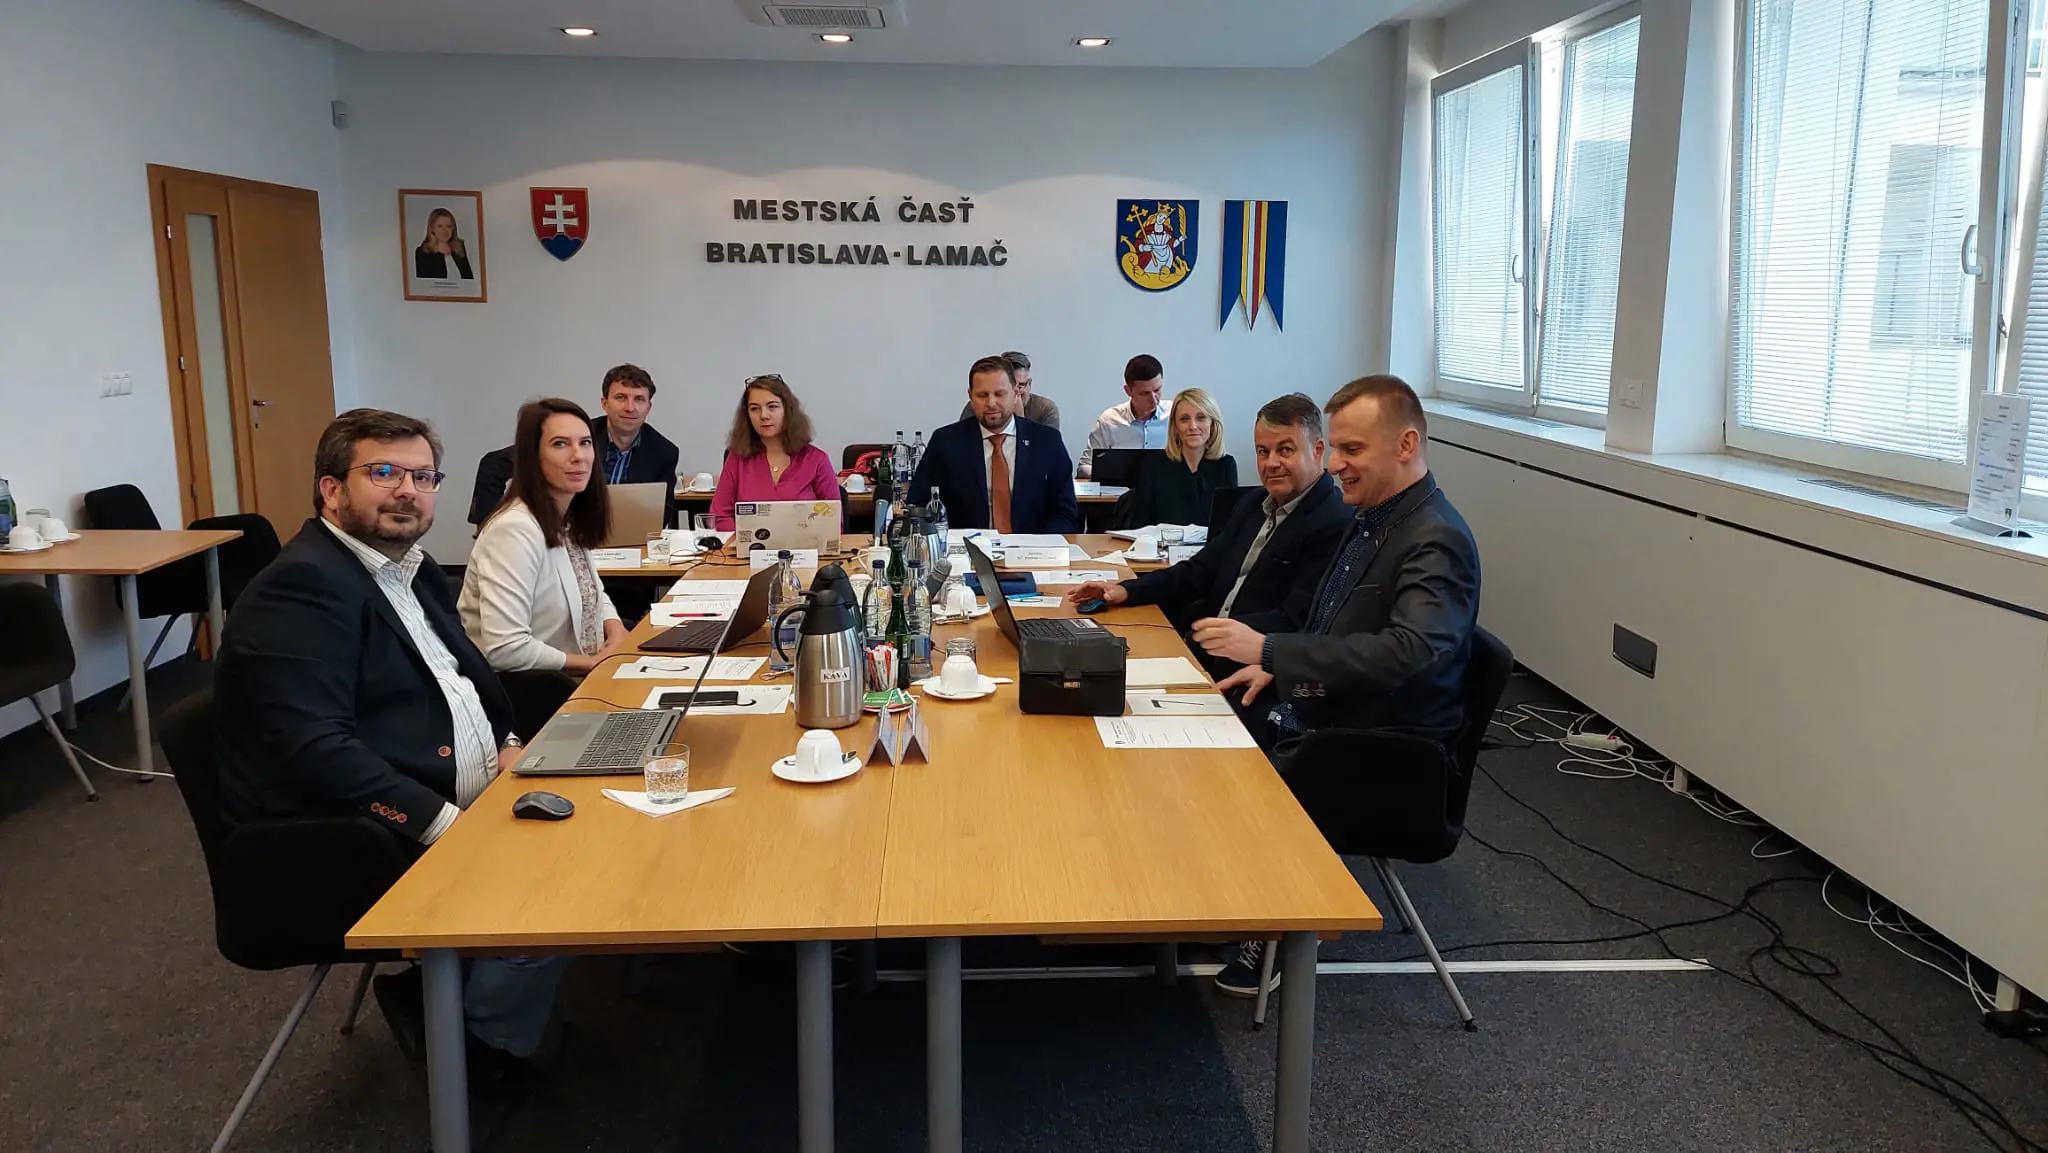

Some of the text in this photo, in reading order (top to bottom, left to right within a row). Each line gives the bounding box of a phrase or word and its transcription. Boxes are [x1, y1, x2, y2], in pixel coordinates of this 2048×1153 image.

[733, 196, 974, 222] MESTSKÁ ČASŤ
[706, 239, 1008, 266] BRATISLAVA-LAMAČ
